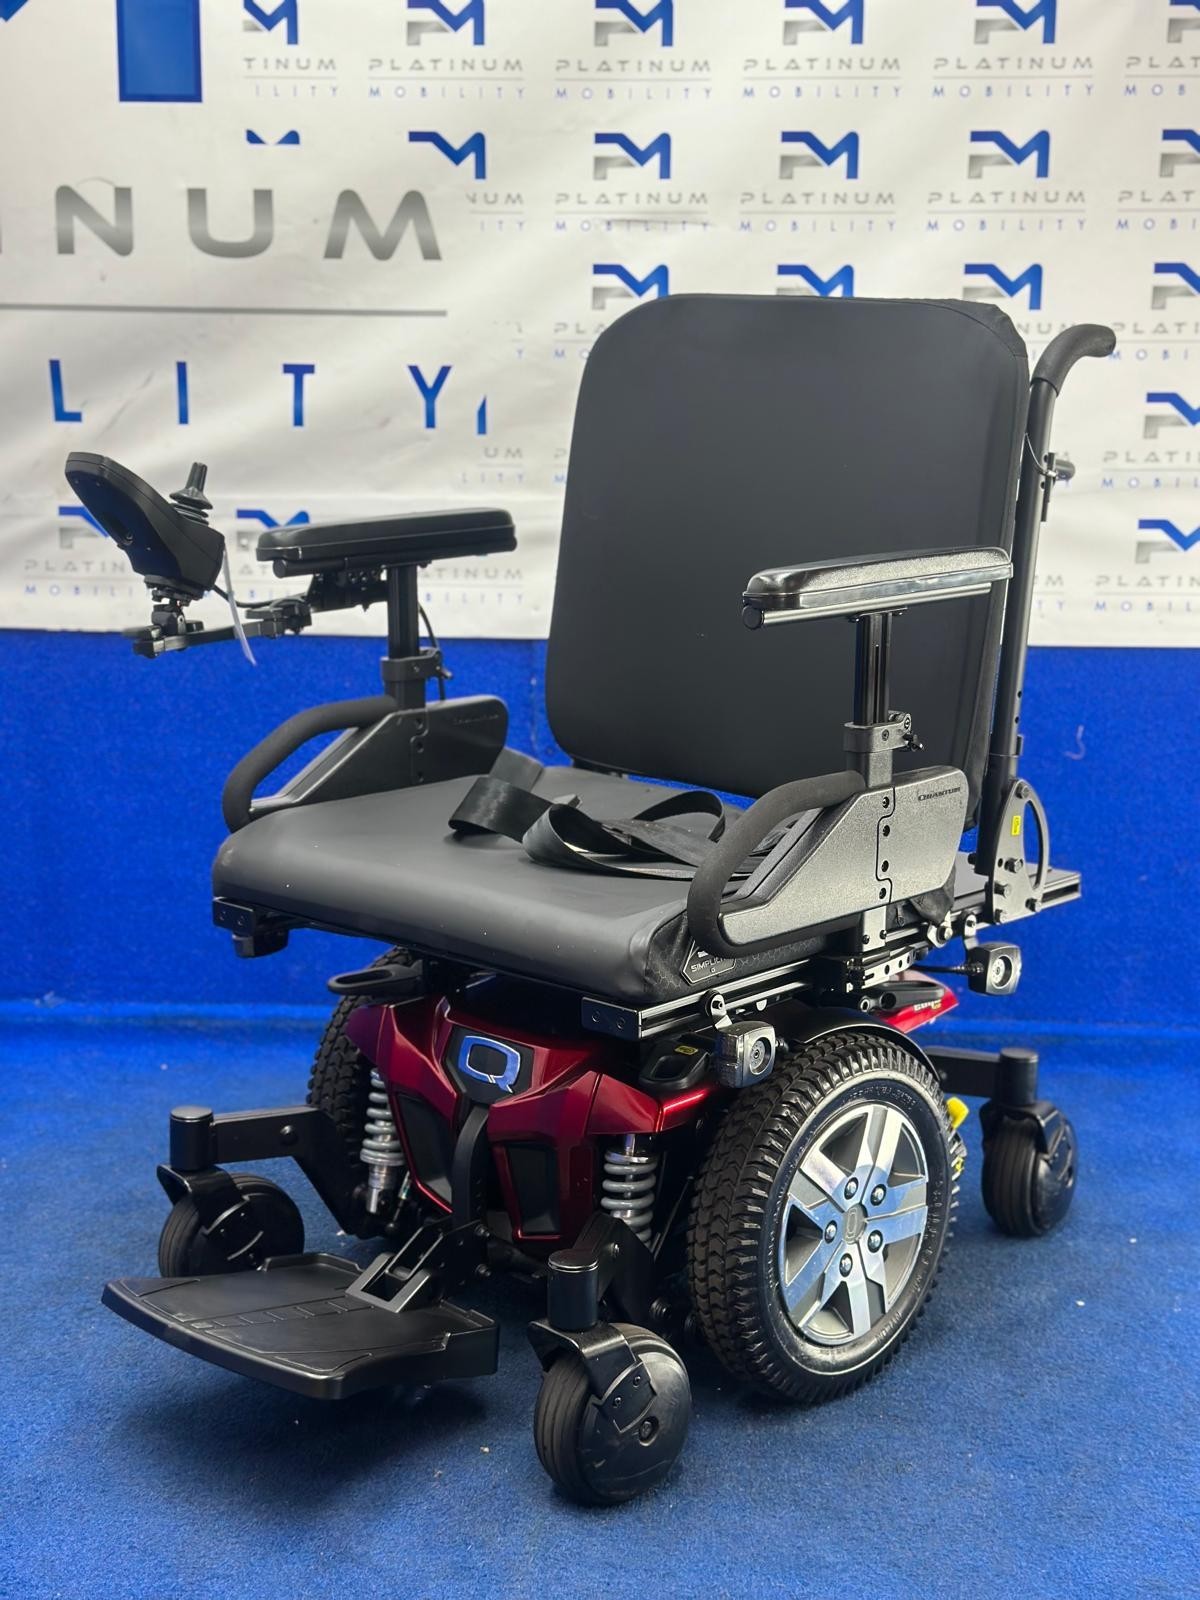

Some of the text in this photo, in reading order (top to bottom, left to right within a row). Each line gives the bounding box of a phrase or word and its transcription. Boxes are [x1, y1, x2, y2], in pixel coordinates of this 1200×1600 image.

[369, 58, 524, 72] PLATINUM
[555, 58, 711, 73] PLATINUM
[743, 57, 900, 71] PLATINUM
[933, 56, 1093, 71] PLATINUM
[369, 86, 526, 98] MOBILITY
[555, 87, 711, 99] MOBILITY
[743, 86, 902, 98] MOBILITY
[933, 85, 1095, 97] MOBILITY
[555, 191, 709, 205] PLATINUM
[740, 191, 895, 205] PLATINUM
[927, 190, 1086, 204] PLATINUM
[555, 220, 710, 232] MOBILITY
[740, 220, 895, 232] MOBILITY
[926, 218, 1086, 231] MOBILITY
